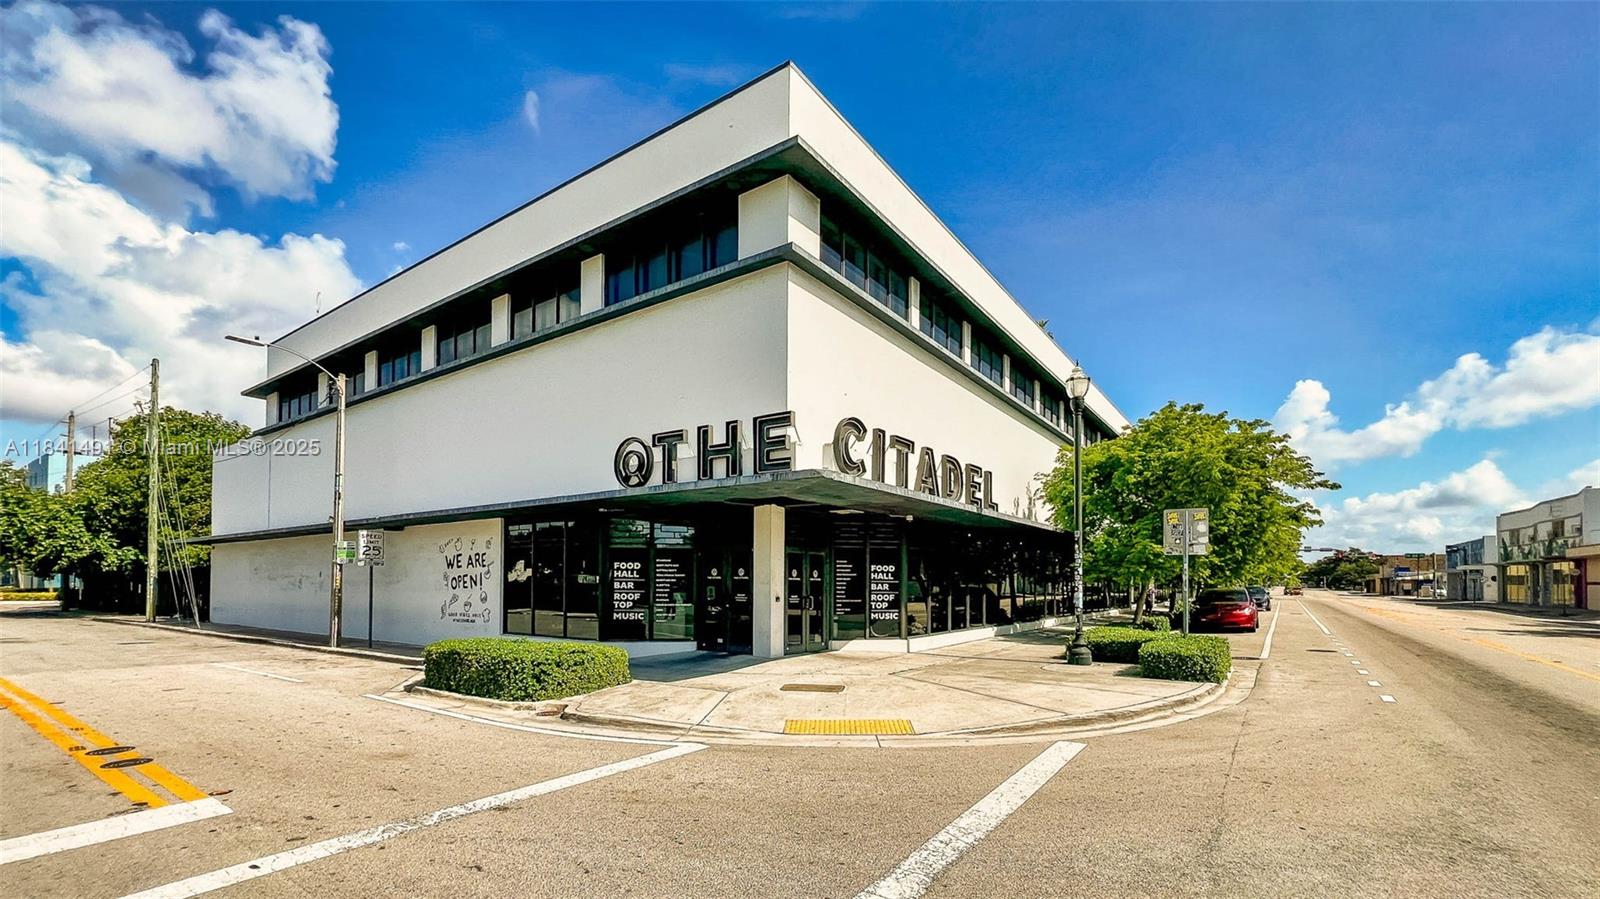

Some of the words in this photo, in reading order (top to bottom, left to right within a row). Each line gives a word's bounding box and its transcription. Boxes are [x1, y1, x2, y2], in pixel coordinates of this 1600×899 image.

[652, 410, 796, 485] THE
[832, 416, 999, 513] CITADEL
[362, 545, 383, 557] 25
[445, 553, 463, 570] WE
[466, 552, 487, 569] ARE
[613, 561, 641, 570] FOOD
[870, 564, 896, 572] FOOD
[613, 570, 640, 578] HALL
[870, 572, 894, 580] HALL
[450, 572, 483, 591] OPEN!
[613, 581, 635, 590] BAR
[870, 583, 890, 591] BAR
[613, 592, 641, 601] ROOF
[870, 594, 895, 602] ROOF
[613, 601, 633, 609] TOP
[870, 602, 889, 610] TOP
[613, 612, 645, 620] MUSIC
[870, 612, 899, 620] MUSIC
